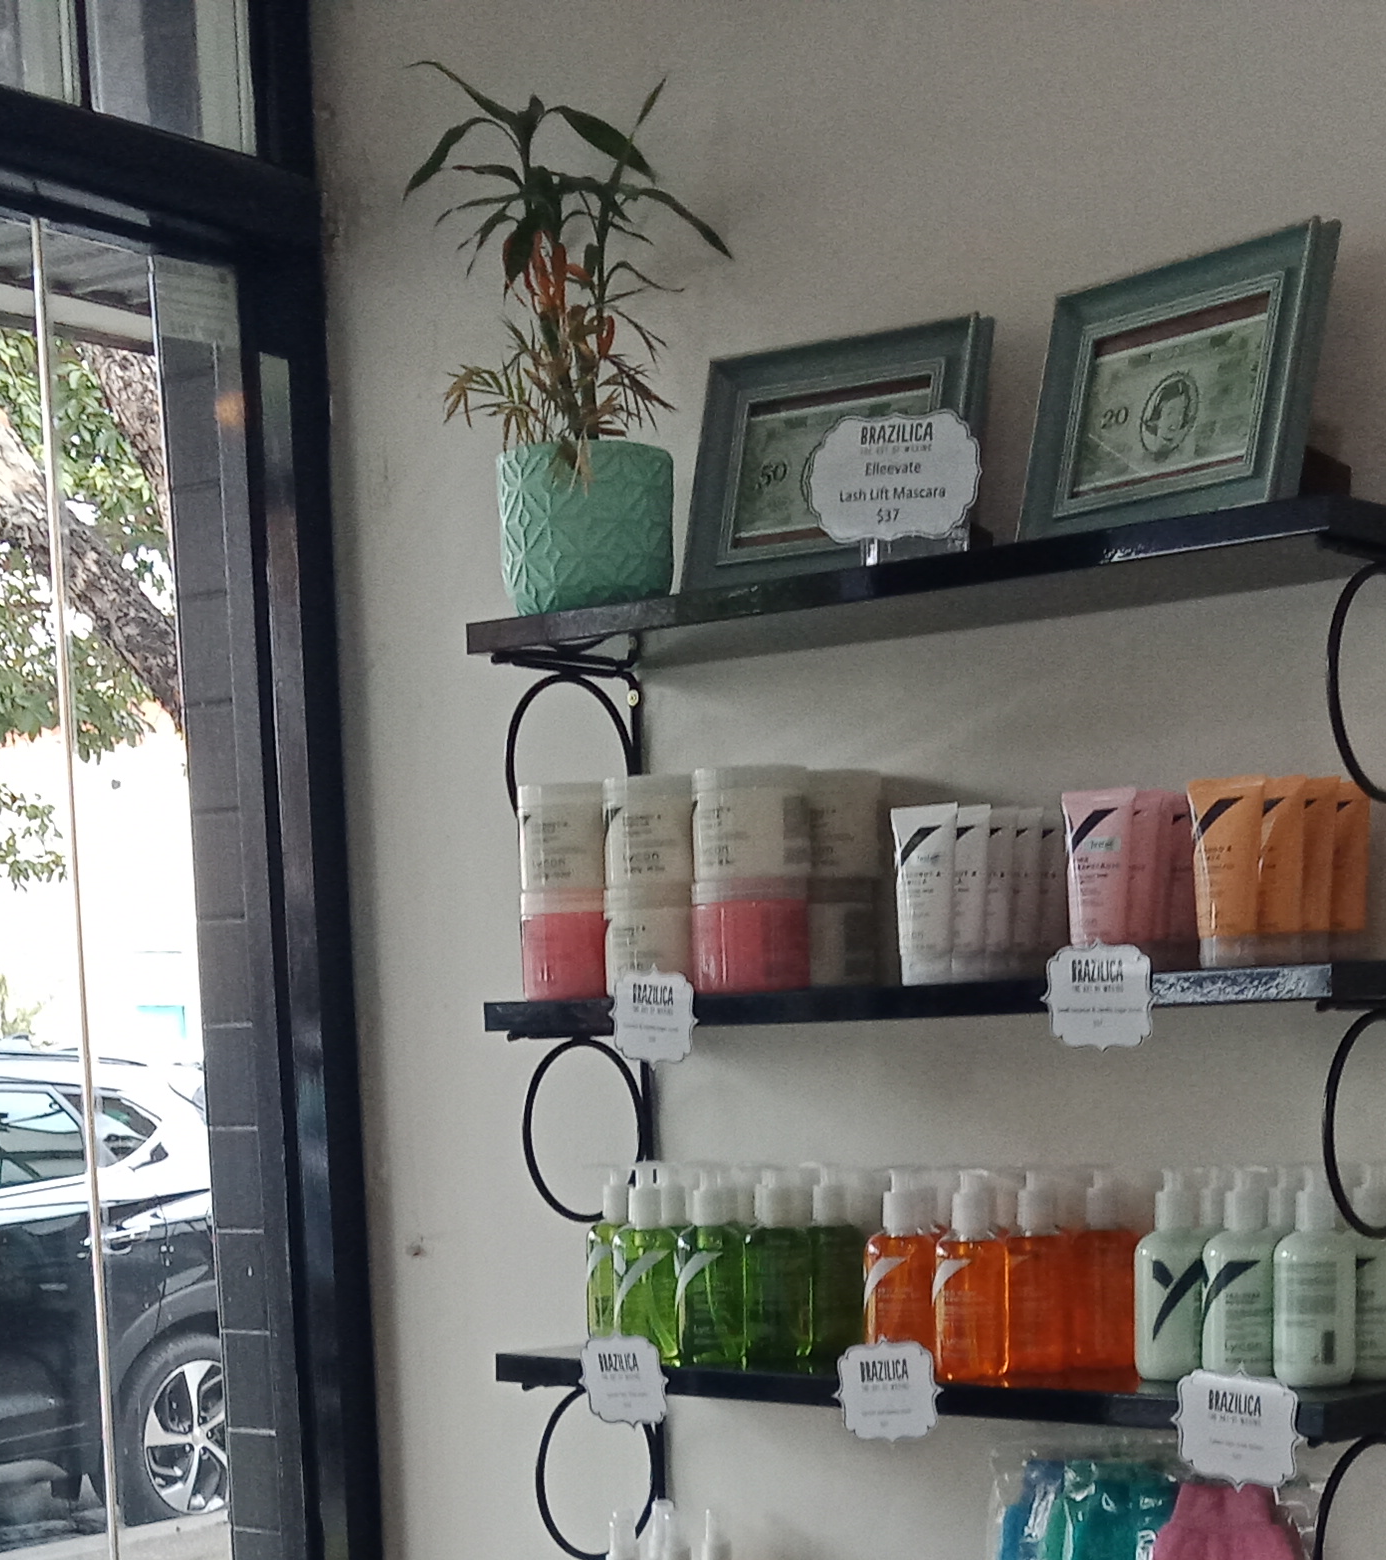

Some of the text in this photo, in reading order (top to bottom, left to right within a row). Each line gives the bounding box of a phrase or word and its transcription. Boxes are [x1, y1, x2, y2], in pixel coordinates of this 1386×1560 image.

[1101, 406, 1129, 430] 20
[860, 422, 933, 445] BRAZILICA
[839, 486, 946, 503] Lash Lift Mascara
[876, 508, 901, 524] $37
[860, 1358, 909, 1383] BRAZILICA
[1208, 1389, 1262, 1417] BRAZILICA
